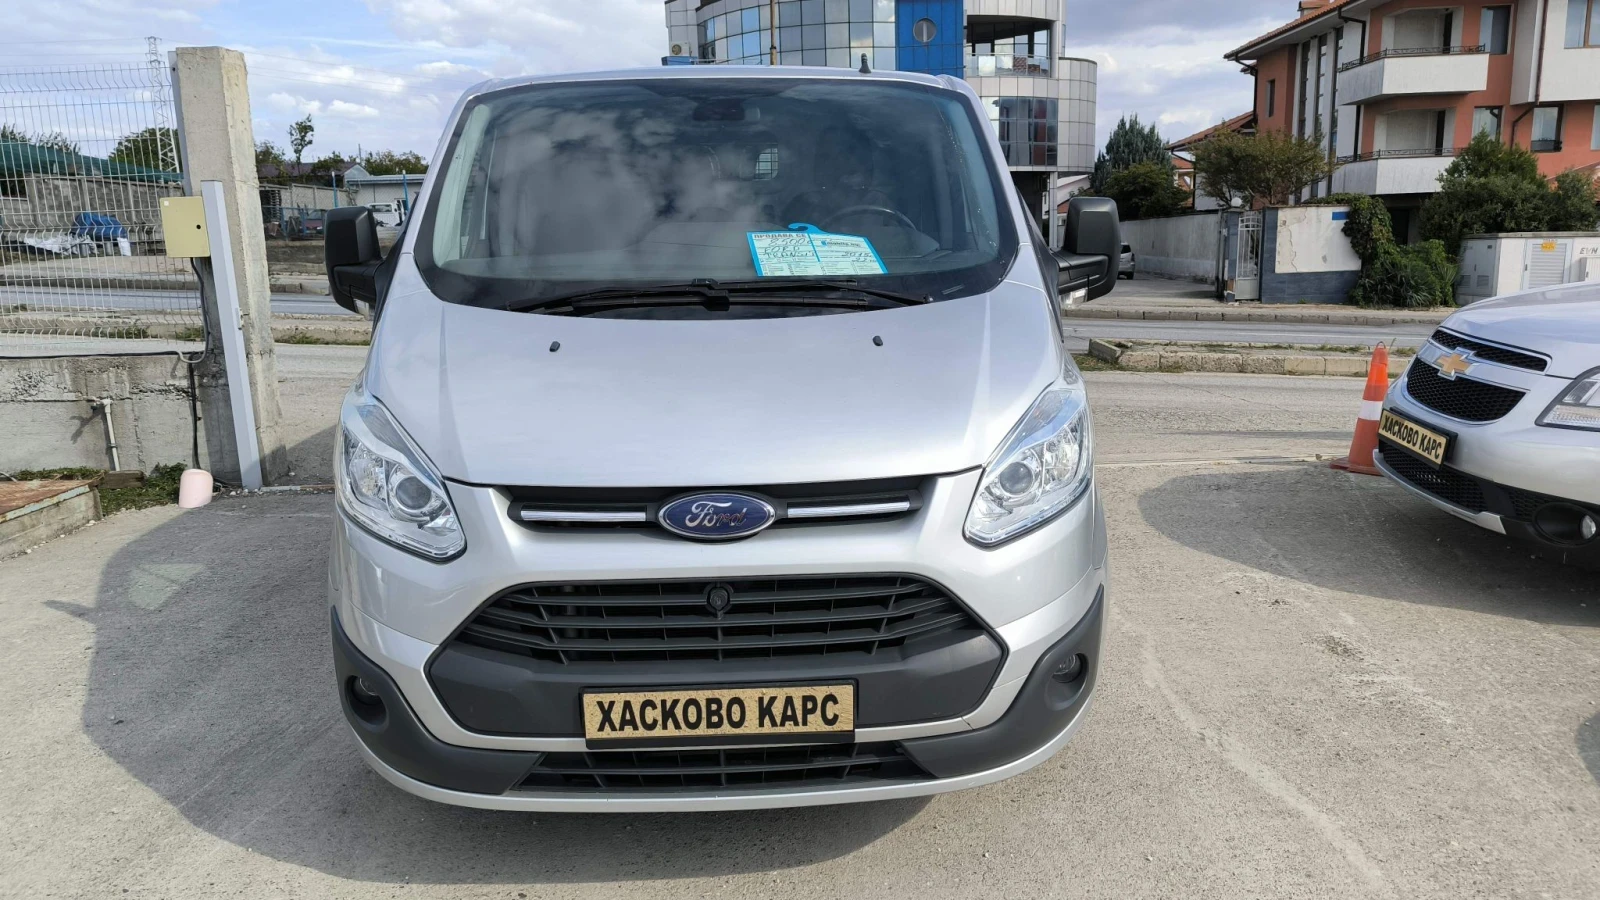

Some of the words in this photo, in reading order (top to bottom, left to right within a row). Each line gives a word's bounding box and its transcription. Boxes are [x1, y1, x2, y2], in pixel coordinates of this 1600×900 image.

[1382, 415, 1419, 447] ХАСКОВО
[1419, 433, 1442, 460] КАРС
[685, 501, 748, 528] Ford
[597, 696, 747, 732] ХАСКОВО
[758, 693, 840, 728] КАРС
